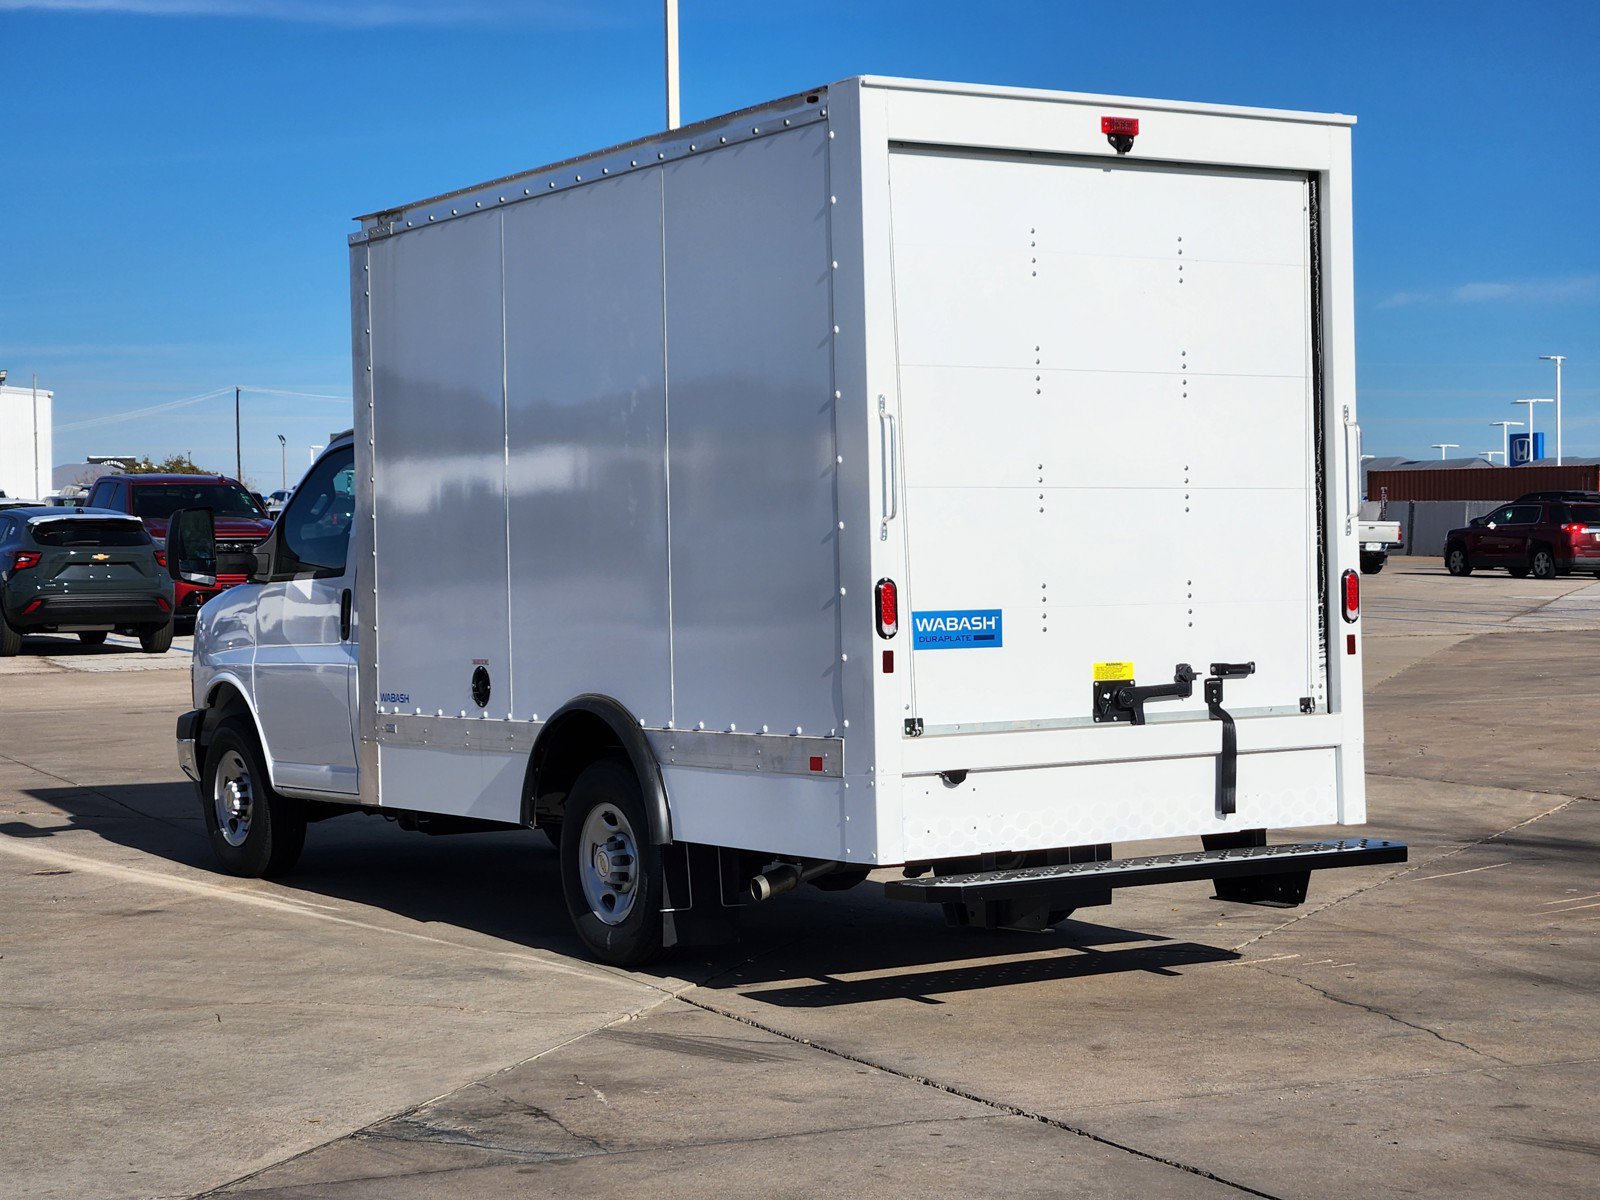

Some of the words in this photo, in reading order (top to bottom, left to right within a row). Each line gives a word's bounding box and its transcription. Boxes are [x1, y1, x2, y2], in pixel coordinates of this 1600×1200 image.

[915, 616, 998, 632] WABASH
[919, 634, 972, 643] DURAPLATE
[380, 692, 410, 703] WABASH
